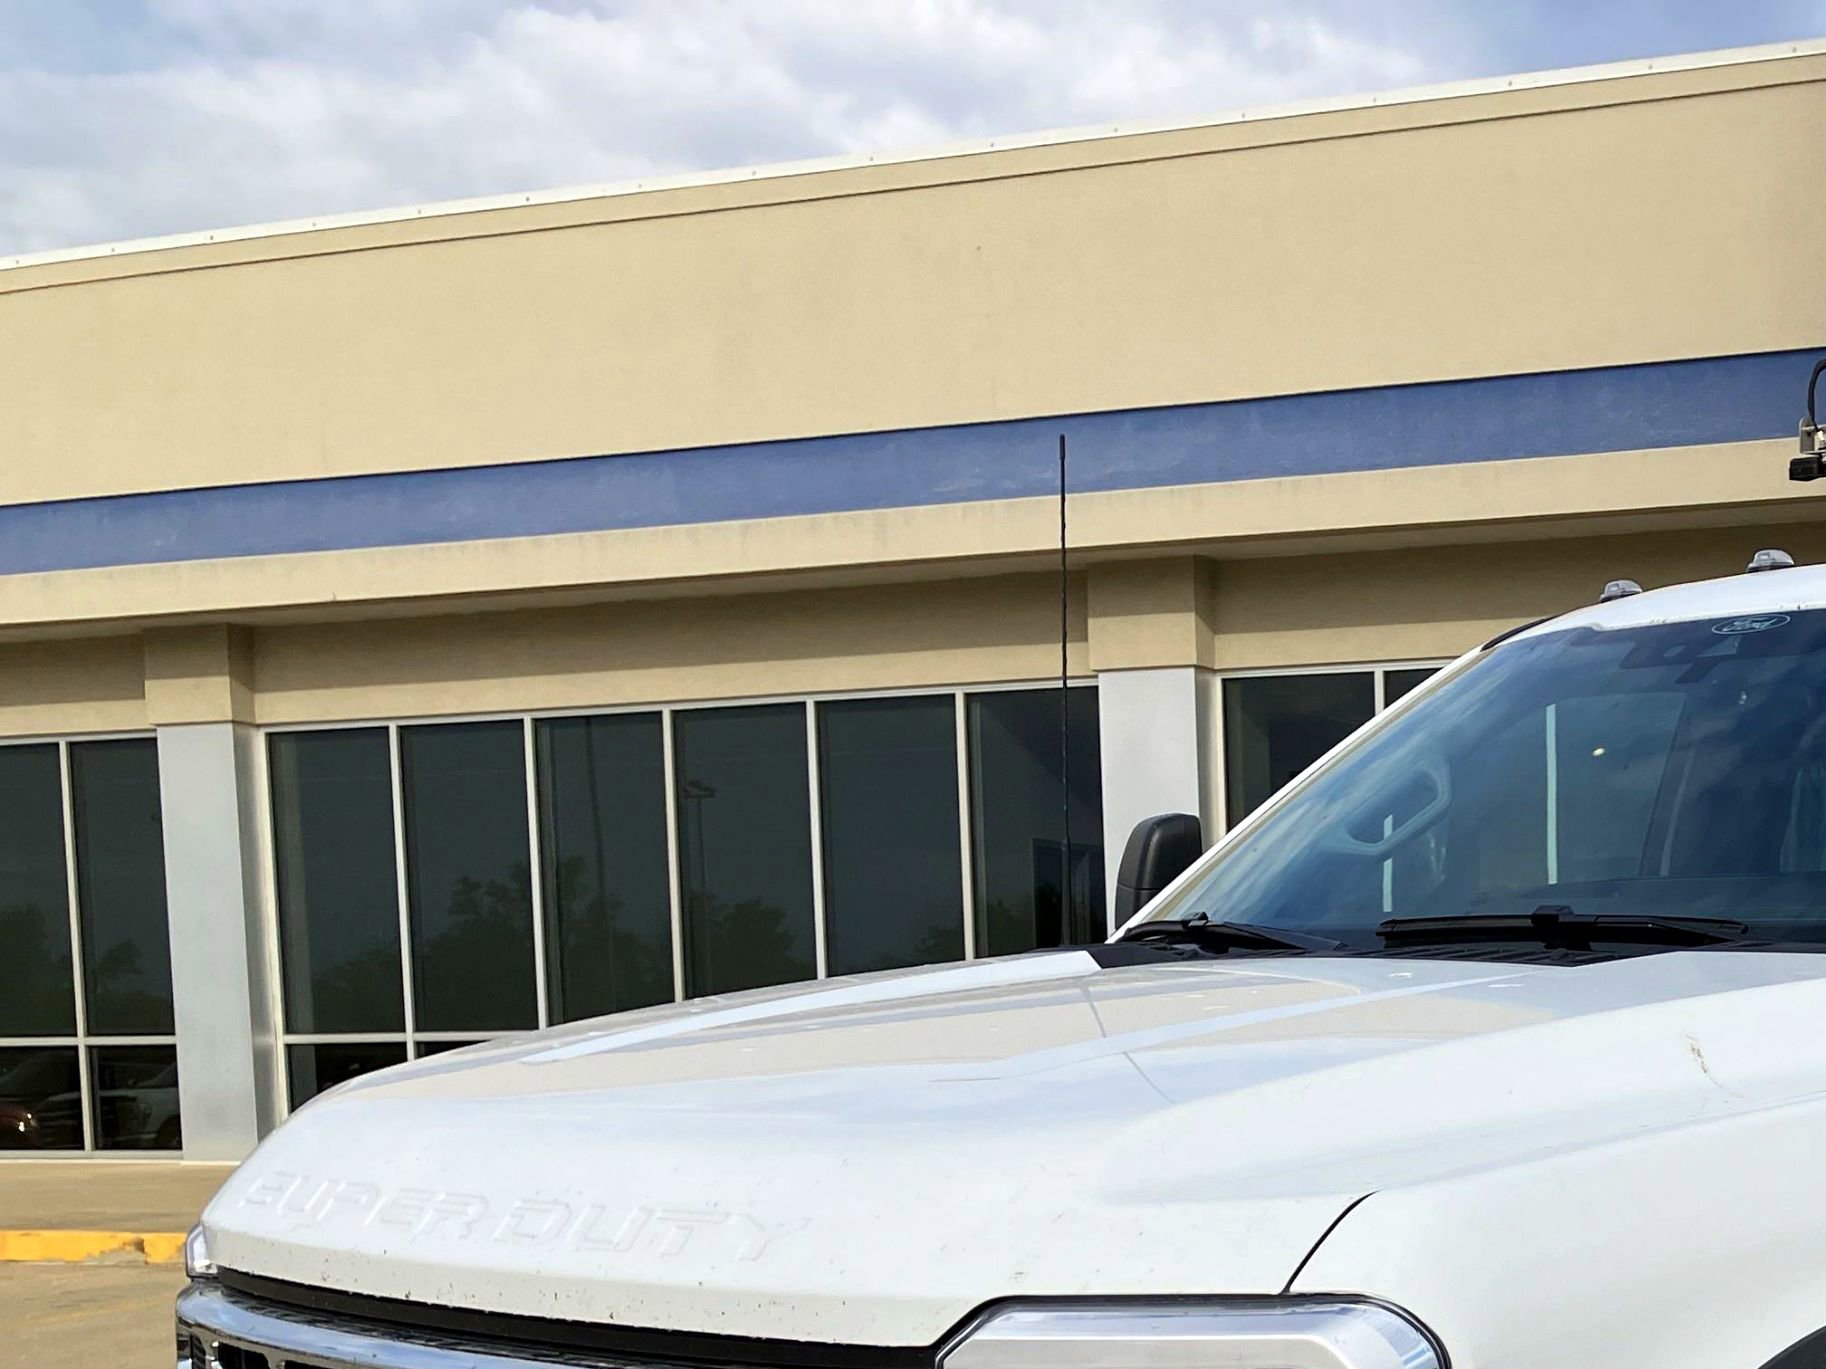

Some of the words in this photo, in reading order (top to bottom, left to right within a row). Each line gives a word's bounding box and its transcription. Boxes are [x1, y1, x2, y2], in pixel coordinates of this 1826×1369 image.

[1722, 616, 1779, 632] Ford
[240, 1170, 488, 1241] SUPER
[494, 1198, 813, 1262] DUTY
